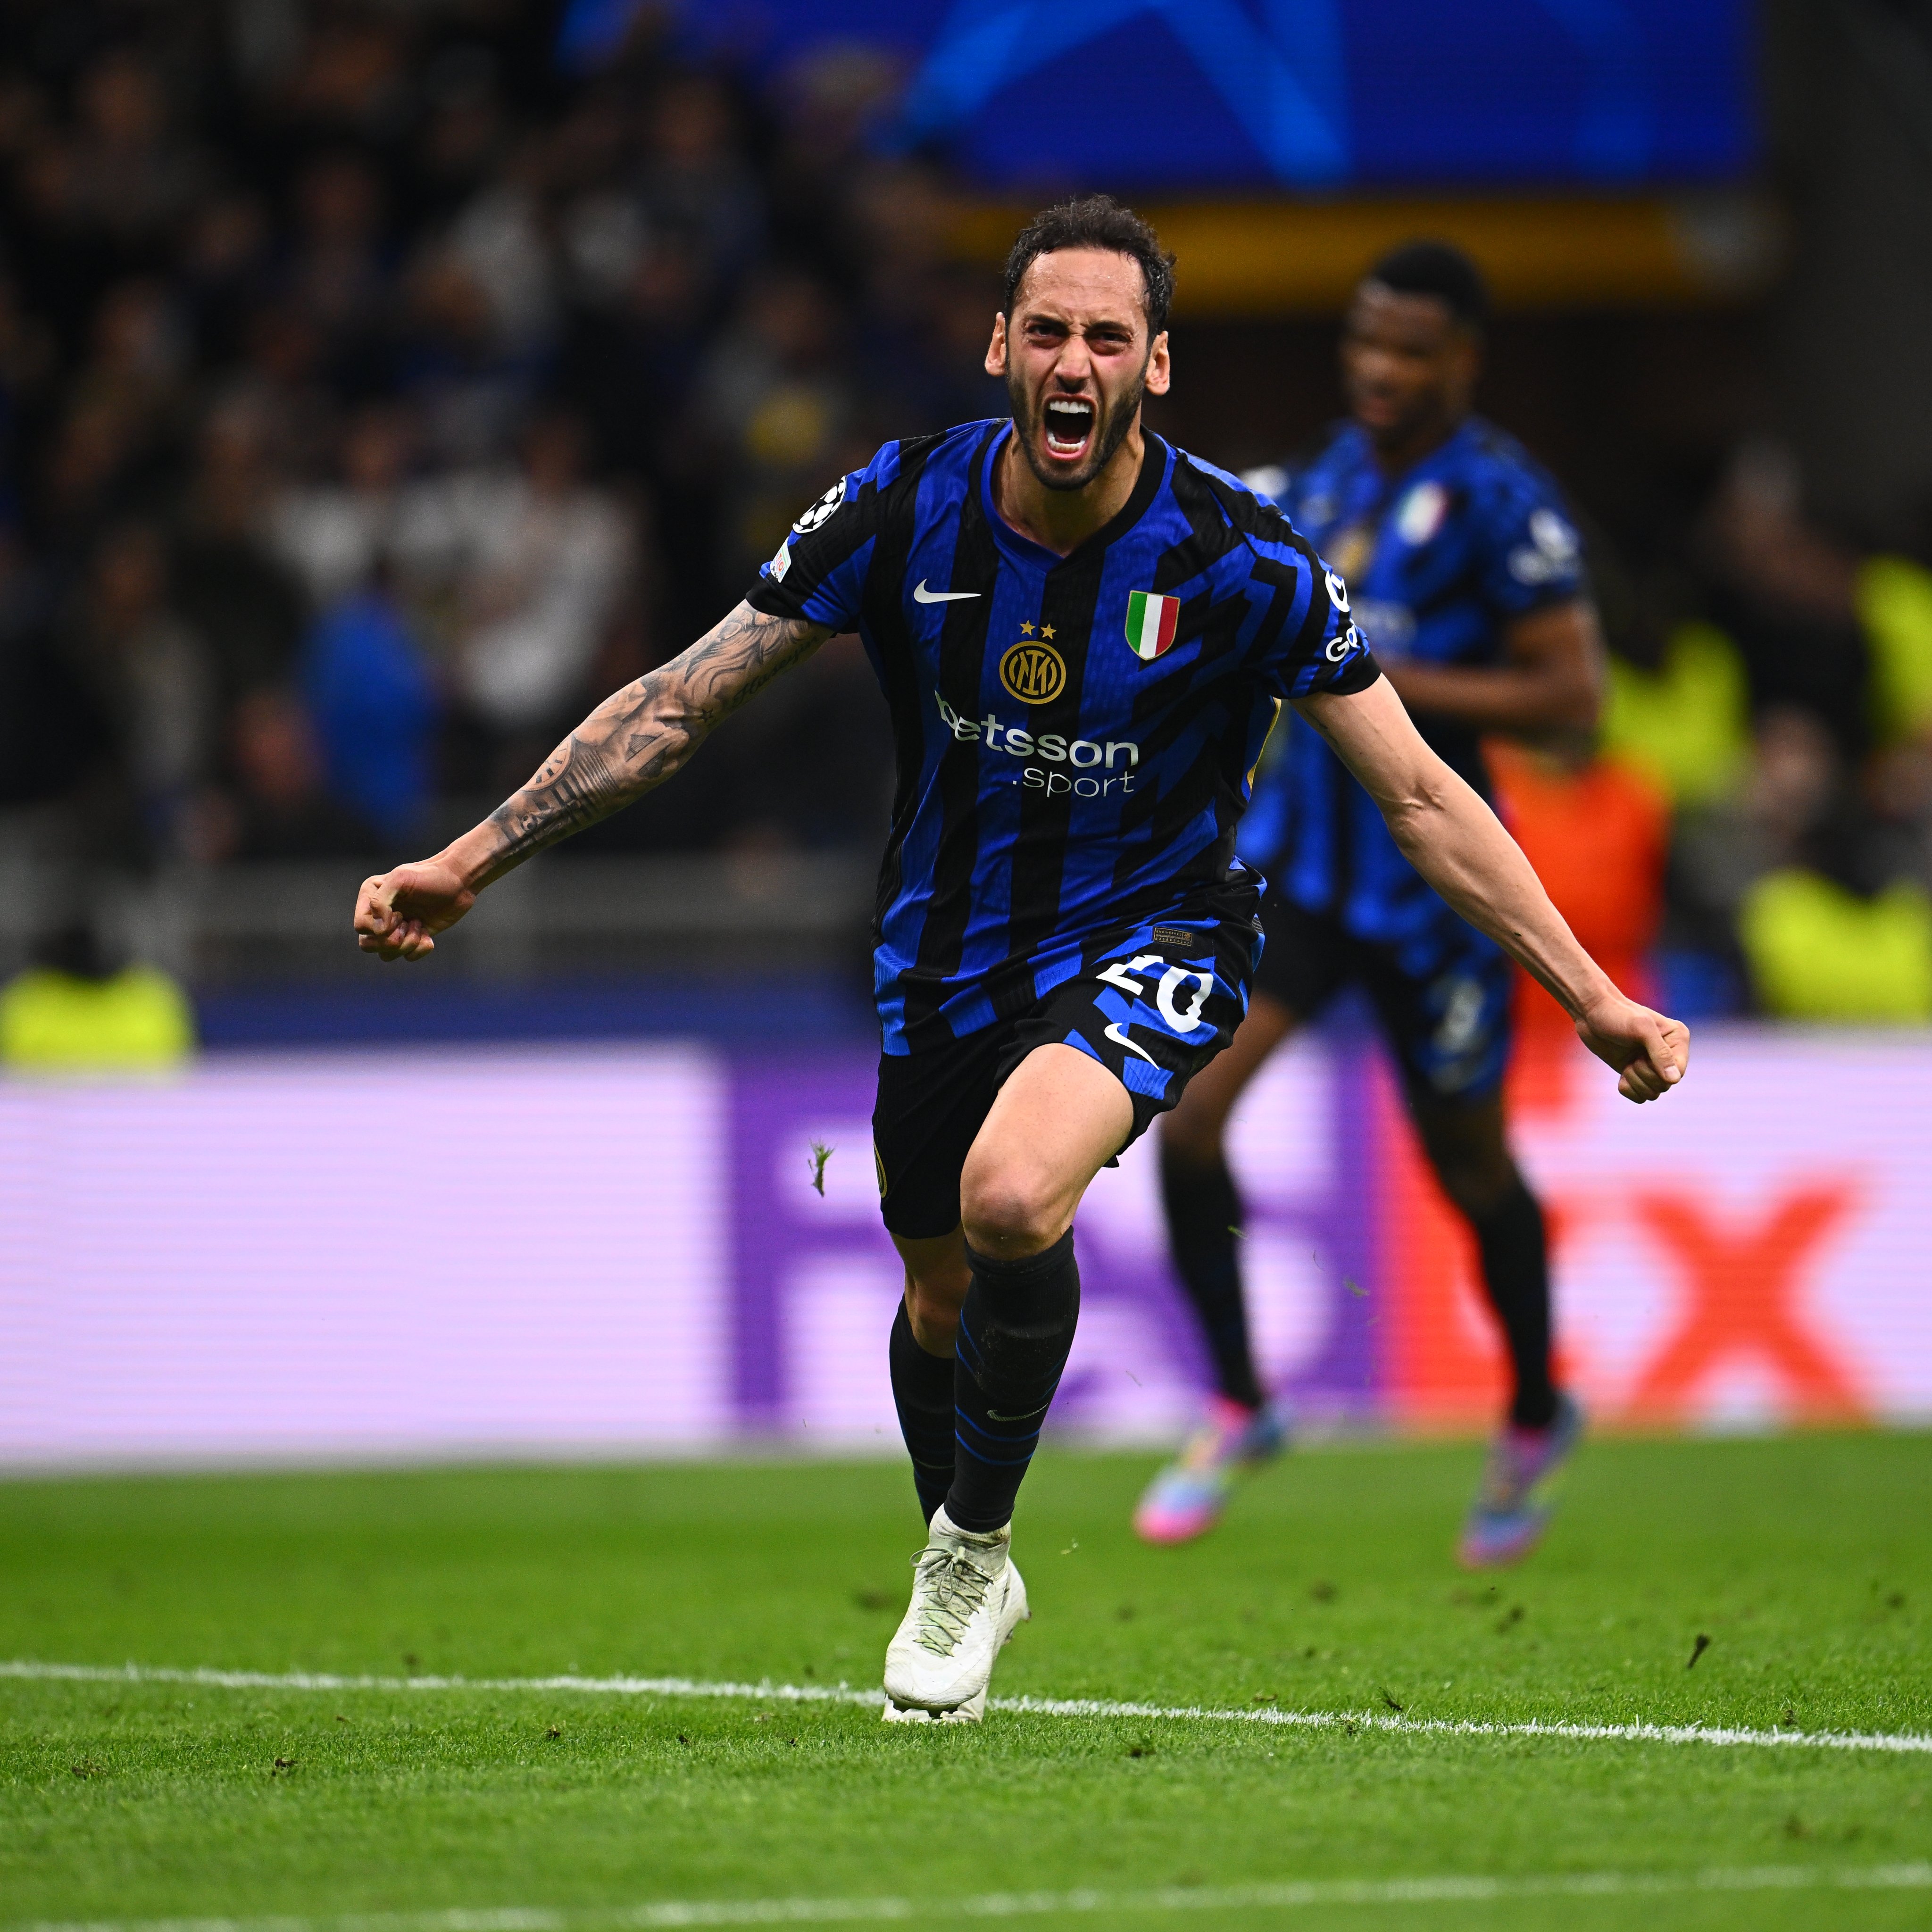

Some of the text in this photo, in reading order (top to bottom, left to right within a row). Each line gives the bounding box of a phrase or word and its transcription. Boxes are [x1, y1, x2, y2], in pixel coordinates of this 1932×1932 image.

[1326, 618, 1360, 661] Ga
[934, 689, 1139, 768] betsson
[1012, 767, 1135, 798] .sport
[1096, 955, 1214, 1033] 20
